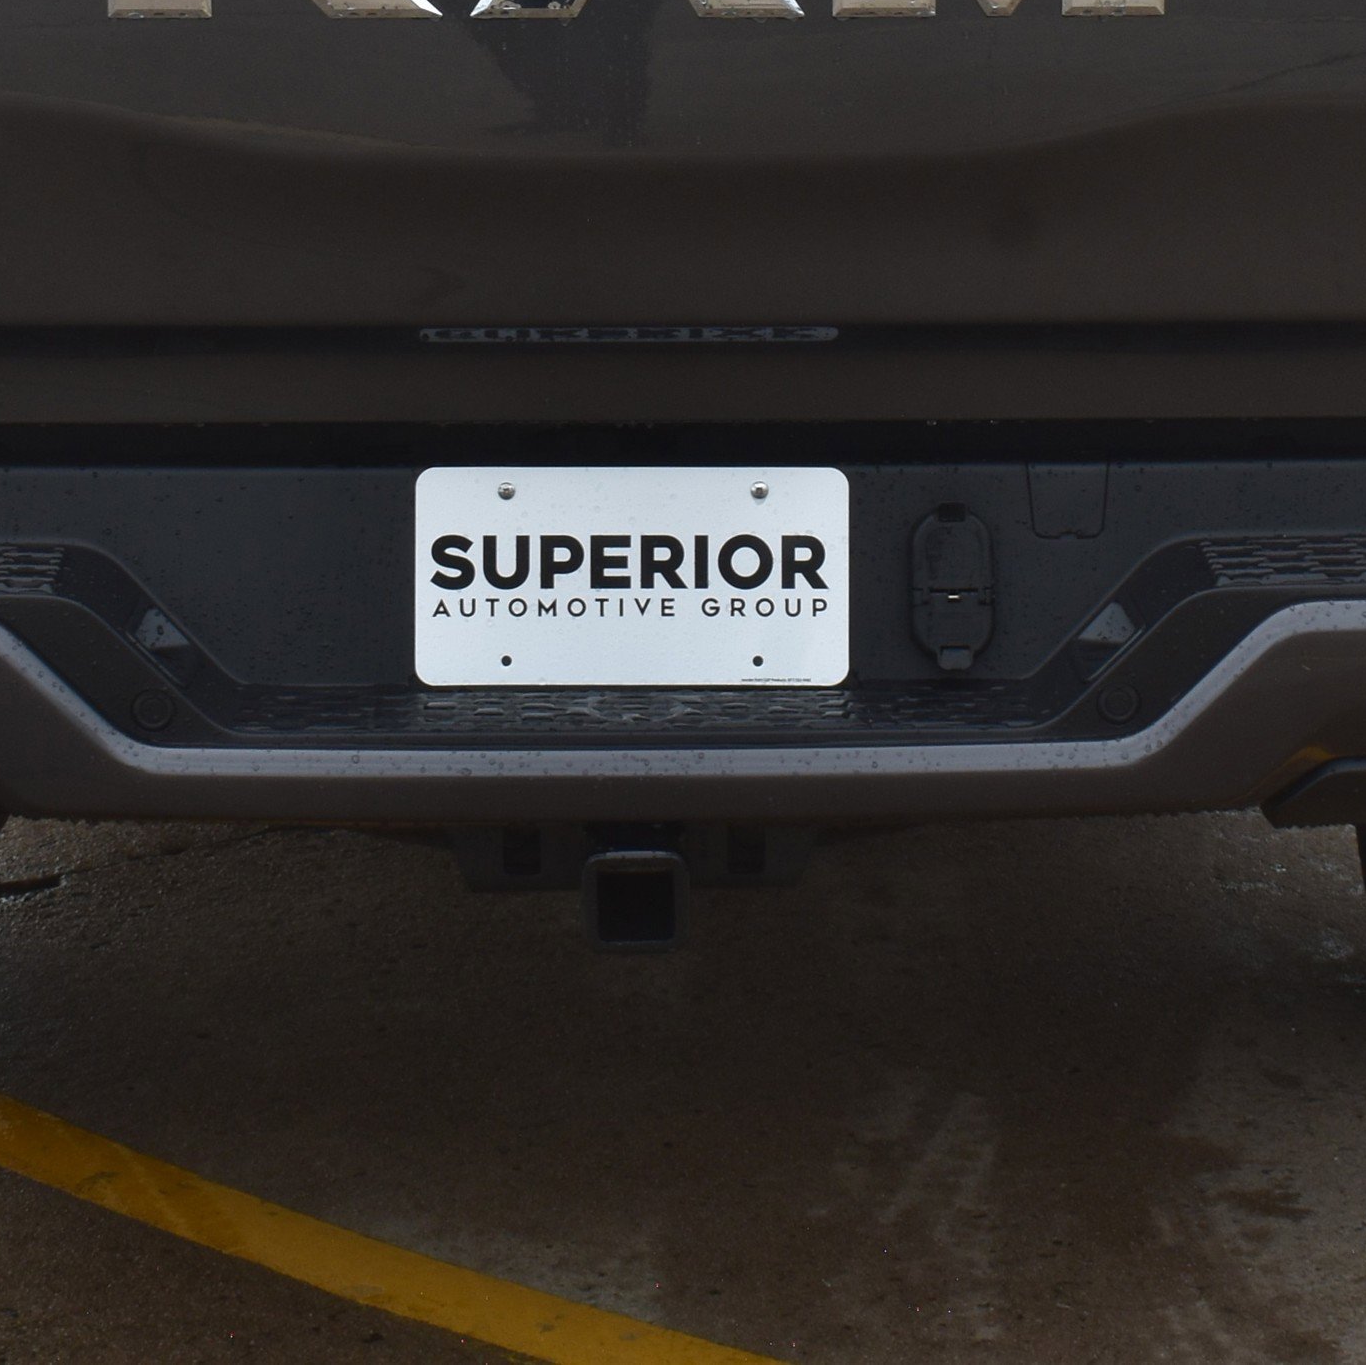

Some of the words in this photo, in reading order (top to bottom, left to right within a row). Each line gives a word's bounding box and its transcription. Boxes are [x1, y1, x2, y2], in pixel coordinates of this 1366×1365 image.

[429, 533, 829, 590] SUPERIOR
[431, 597, 677, 618] AUTOMOTIVE
[701, 597, 829, 618] GROUP
